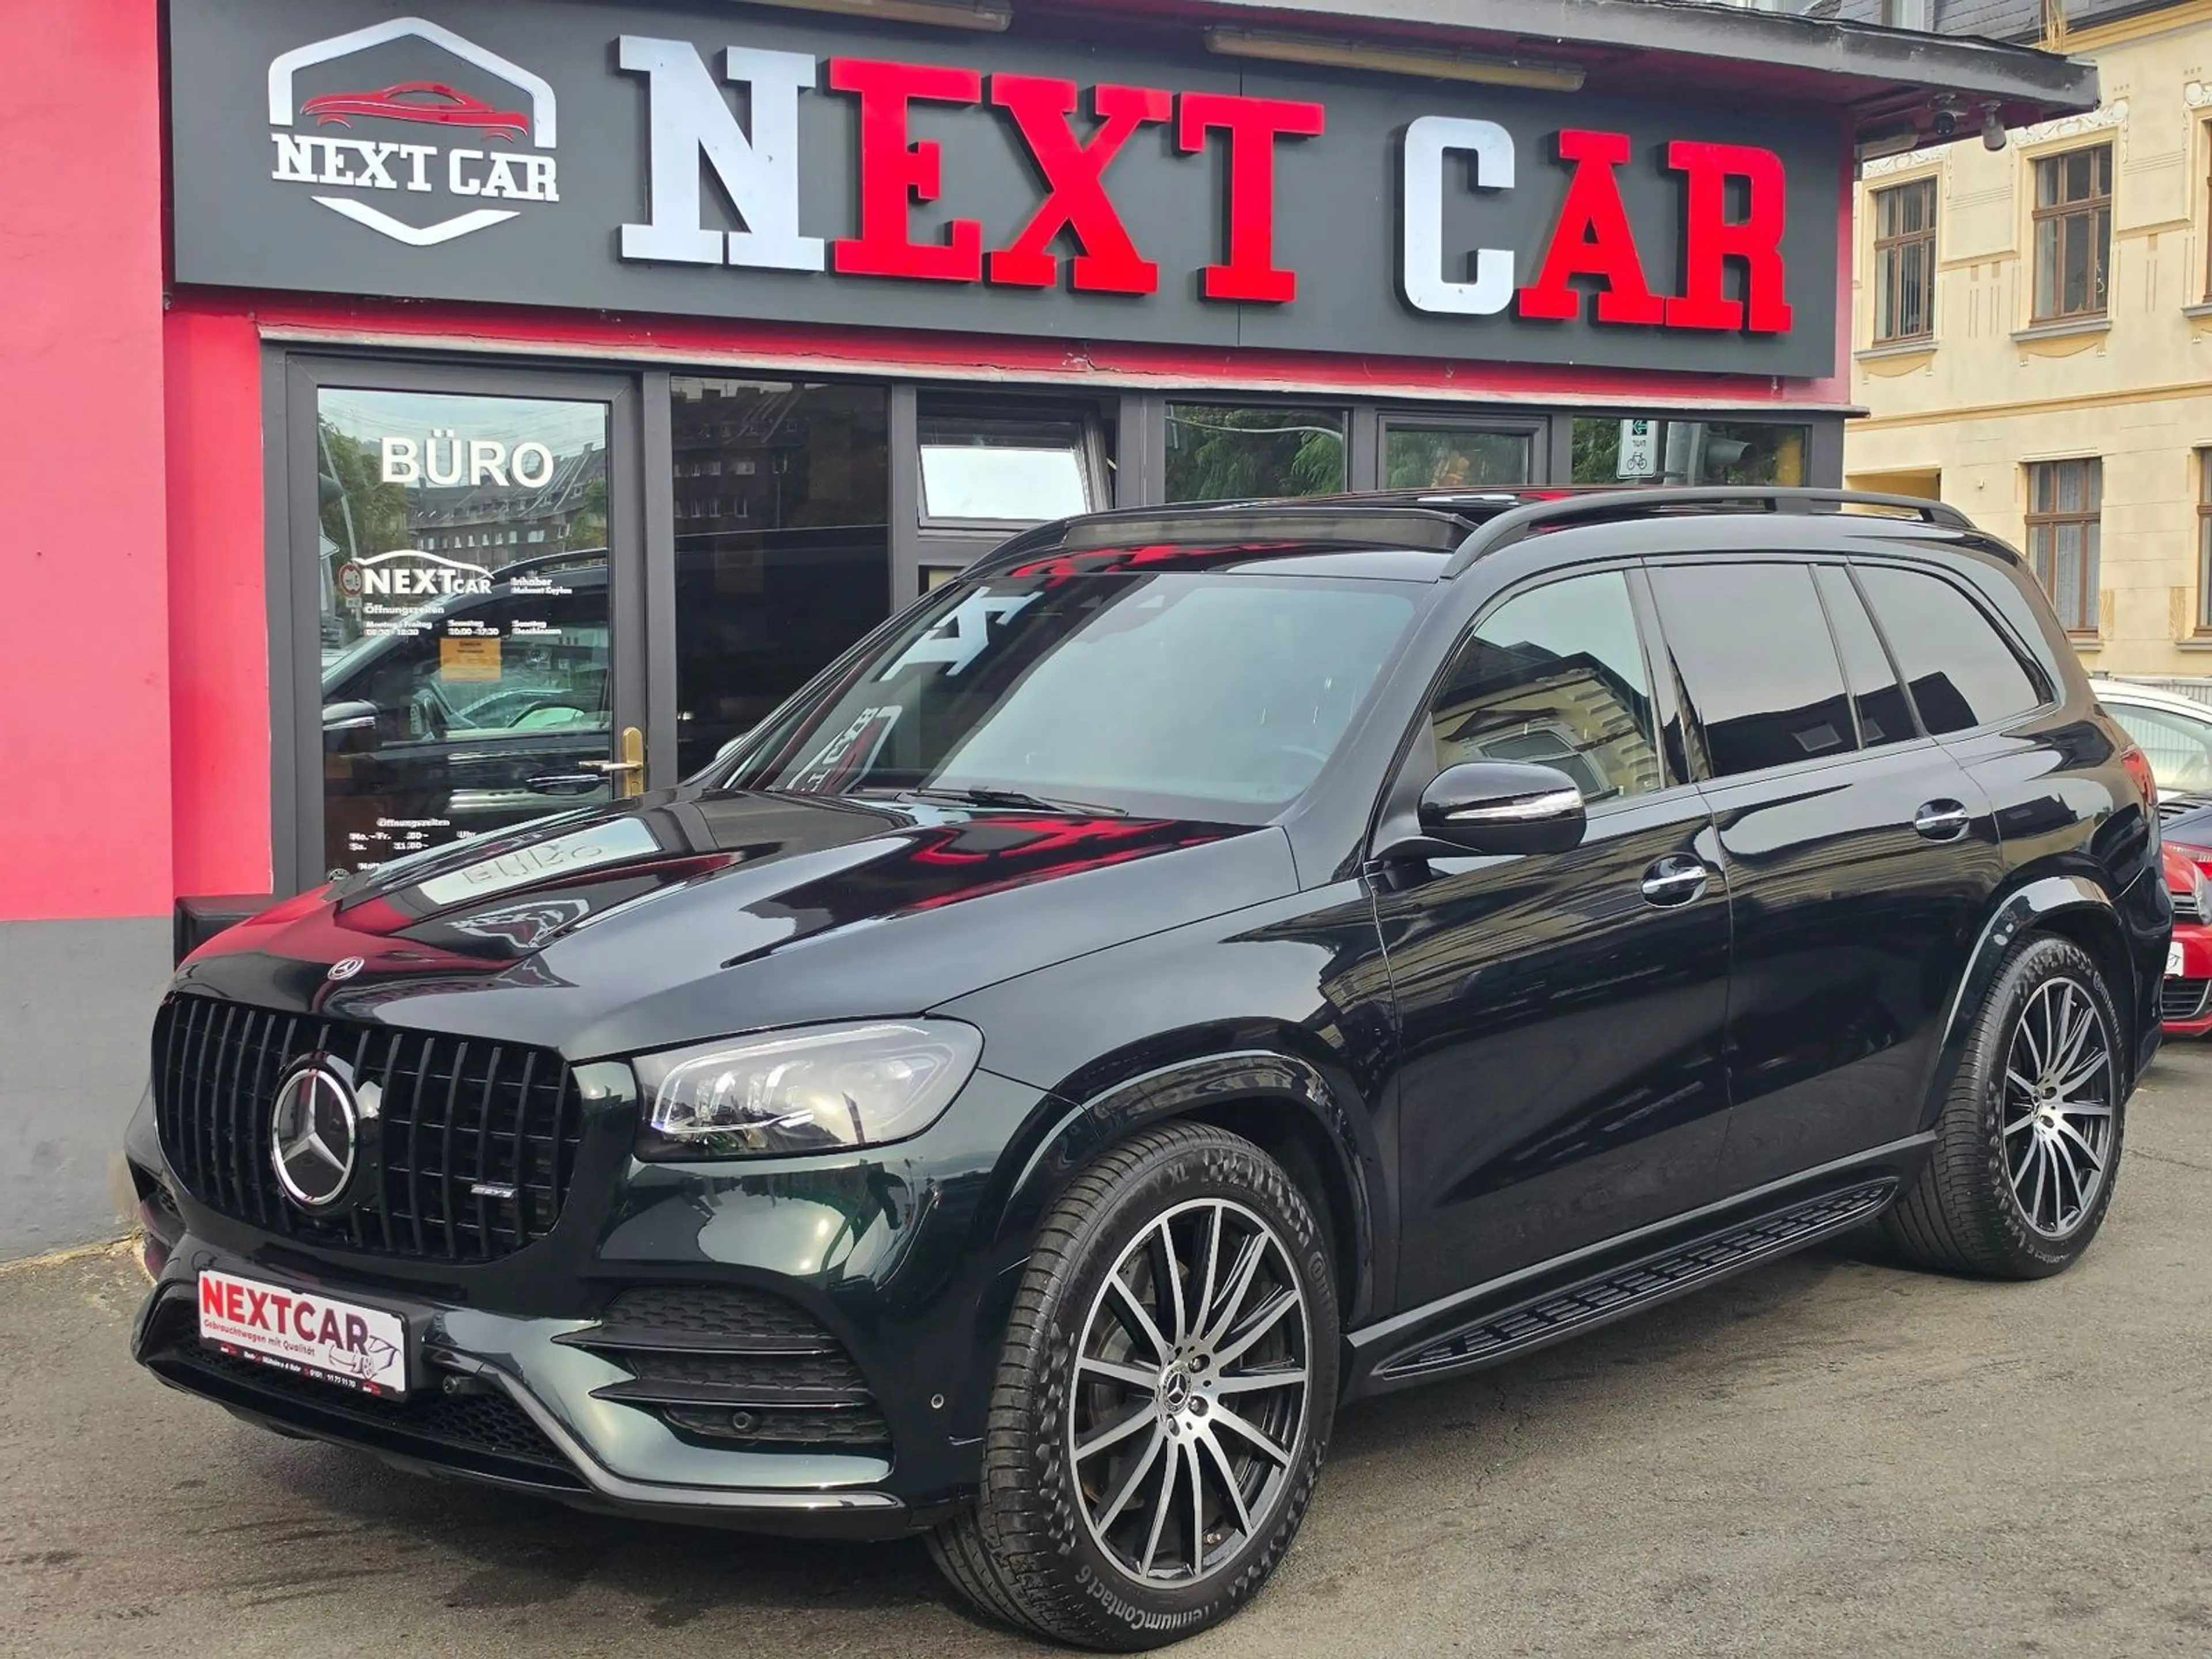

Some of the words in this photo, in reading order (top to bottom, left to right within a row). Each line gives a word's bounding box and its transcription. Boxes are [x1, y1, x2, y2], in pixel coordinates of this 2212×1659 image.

[271, 133, 438, 192] NEXT
[449, 148, 559, 202] CAR
[616, 35, 1325, 302] NEXT
[1403, 115, 1793, 332] CAR
[380, 429, 555, 488] BÜRO
[363, 602, 445, 615] Öffnungszeiten
[376, 817, 450, 828] Öffnungszeiten
[202, 1277, 369, 1356] NEXTCAR
[204, 1319, 267, 1343] Gebrauchtwagen
[268, 1336, 281, 1347] mit
[283, 1340, 315, 1356] Qualität
[1075, 1565, 1092, 1584] 6
